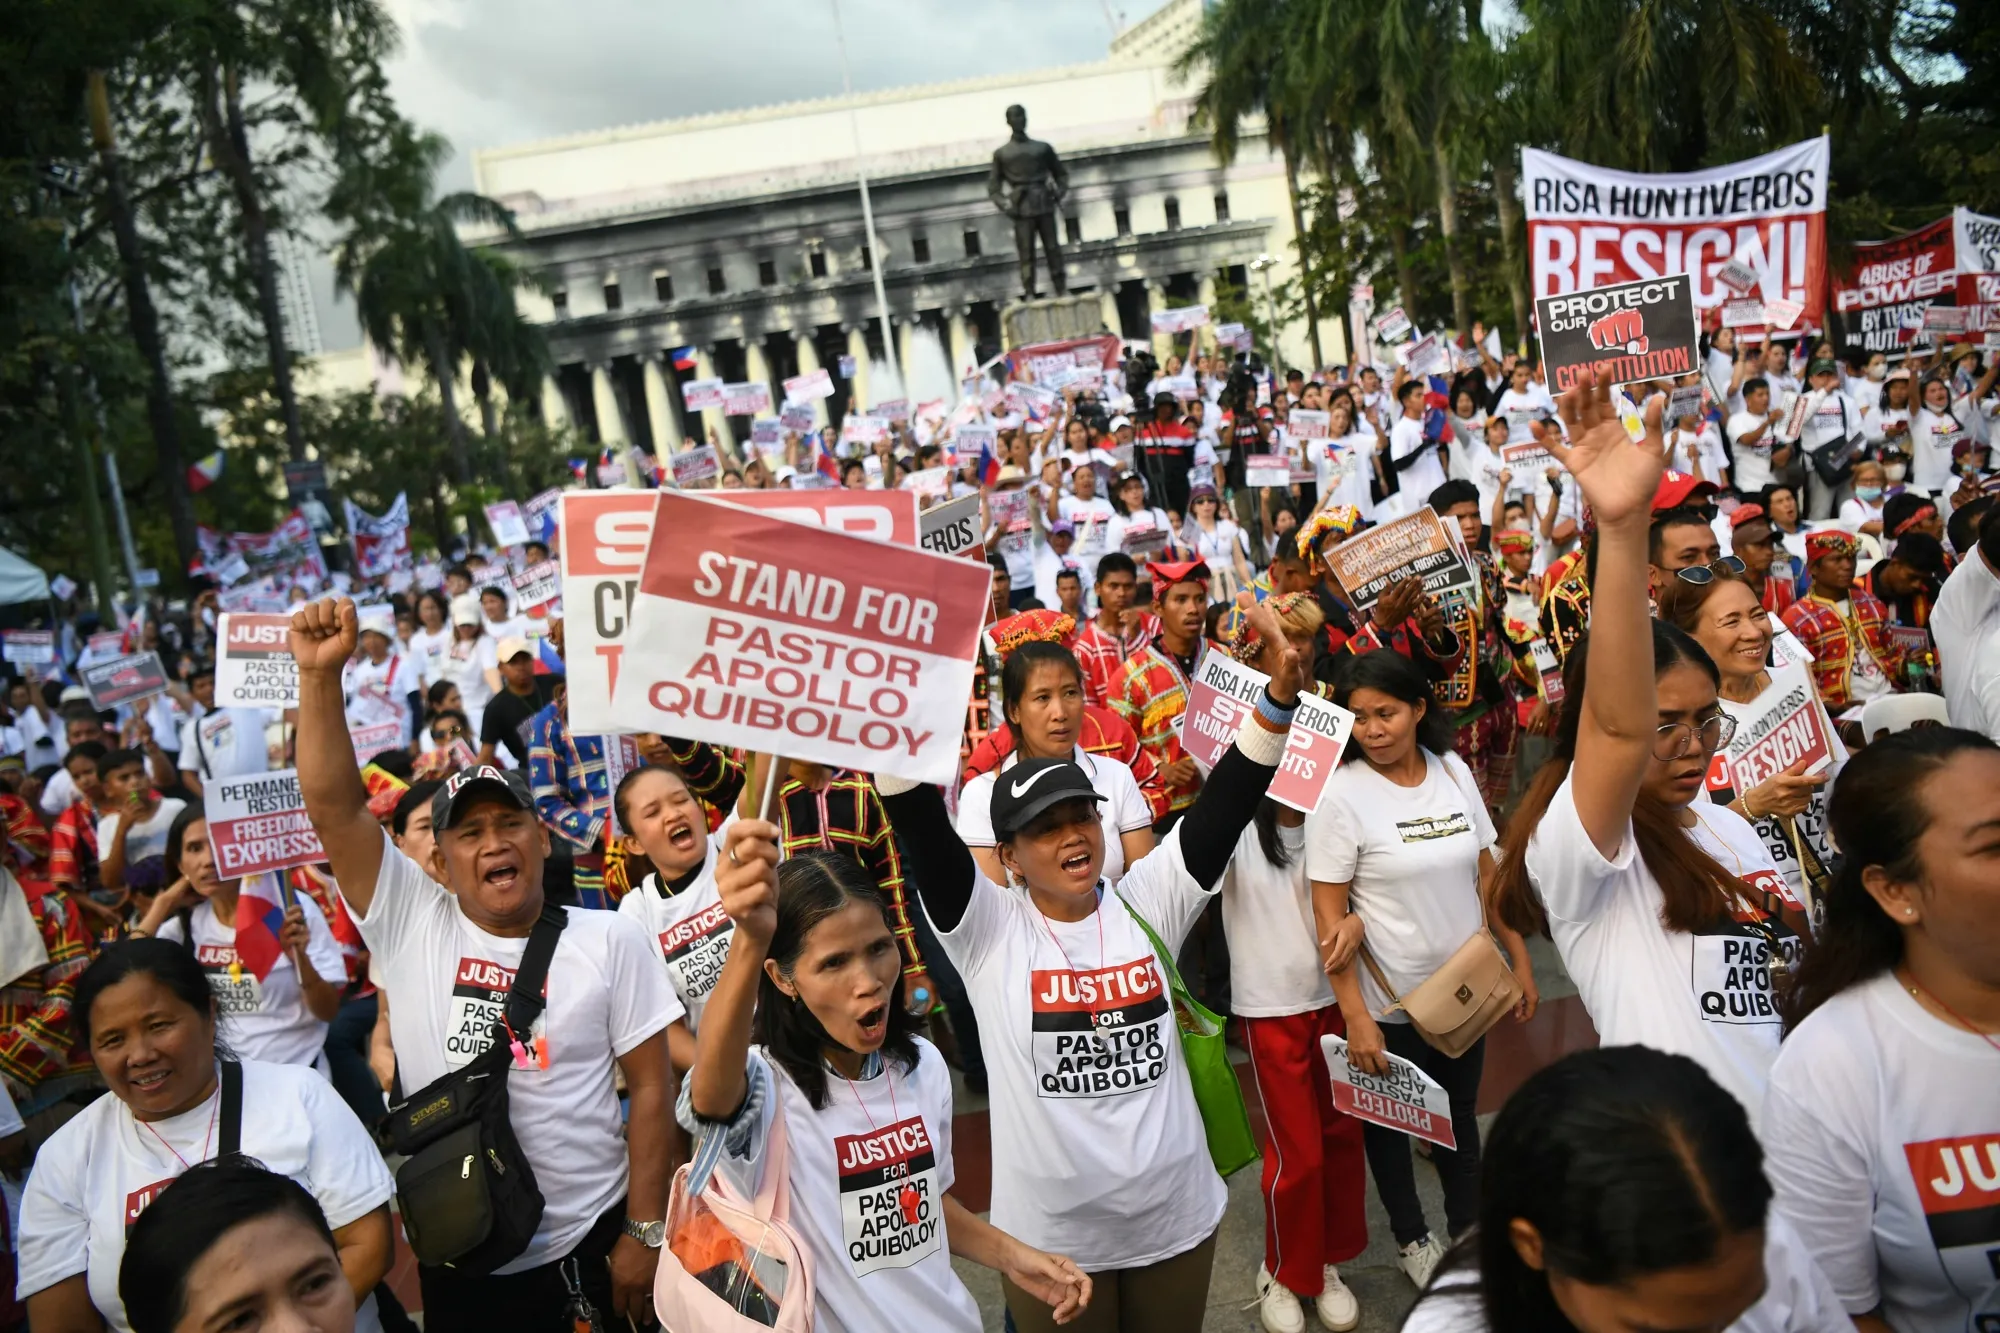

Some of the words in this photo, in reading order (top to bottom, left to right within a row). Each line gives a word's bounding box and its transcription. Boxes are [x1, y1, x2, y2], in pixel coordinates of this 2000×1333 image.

[1534, 178, 1601, 214] RISA
[1610, 170, 1815, 218] HONTIVEROS
[1859, 257, 1911, 287] ABUSE
[1914, 251, 1936, 276] OF
[1548, 281, 1680, 320] PROTECT
[1551, 316, 1588, 333] OUR
[1341, 542, 1370, 564] STOP
[1355, 586, 1369, 600] OF
[1389, 565, 1416, 582] CIVIL
[1413, 551, 1449, 573] RIGHTS
[694, 551, 845, 622] STAND
[853, 586, 938, 645] FOR
[230, 625, 290, 644] JUST
[706, 617, 921, 688] PASTOR
[244, 675, 300, 687] APOLL
[245, 662, 300, 674] PASTO
[686, 653, 908, 718] APOLLO
[1204, 663, 1240, 697] RISA
[233, 687, 300, 701] QUIBOL
[648, 681, 933, 756] QUIBOLOY
[1193, 710, 1238, 745] HUMA
[663, 903, 728, 950] JUSTICE
[689, 935, 711, 950] FOR
[679, 937, 730, 974] PASTOR
[1041, 961, 1157, 1004] JUSTICE
[1056, 1042, 1164, 1075] APOLLO
[1041, 1061, 1163, 1094] QUIBOLO
[1348, 1072, 1426, 1109] PASTOR
[1353, 1088, 1432, 1132] PROTECT
[842, 1122, 929, 1169] JUSTICE
[883, 1163, 907, 1180] FOR
[850, 1217, 937, 1262] QUIBOLOY
